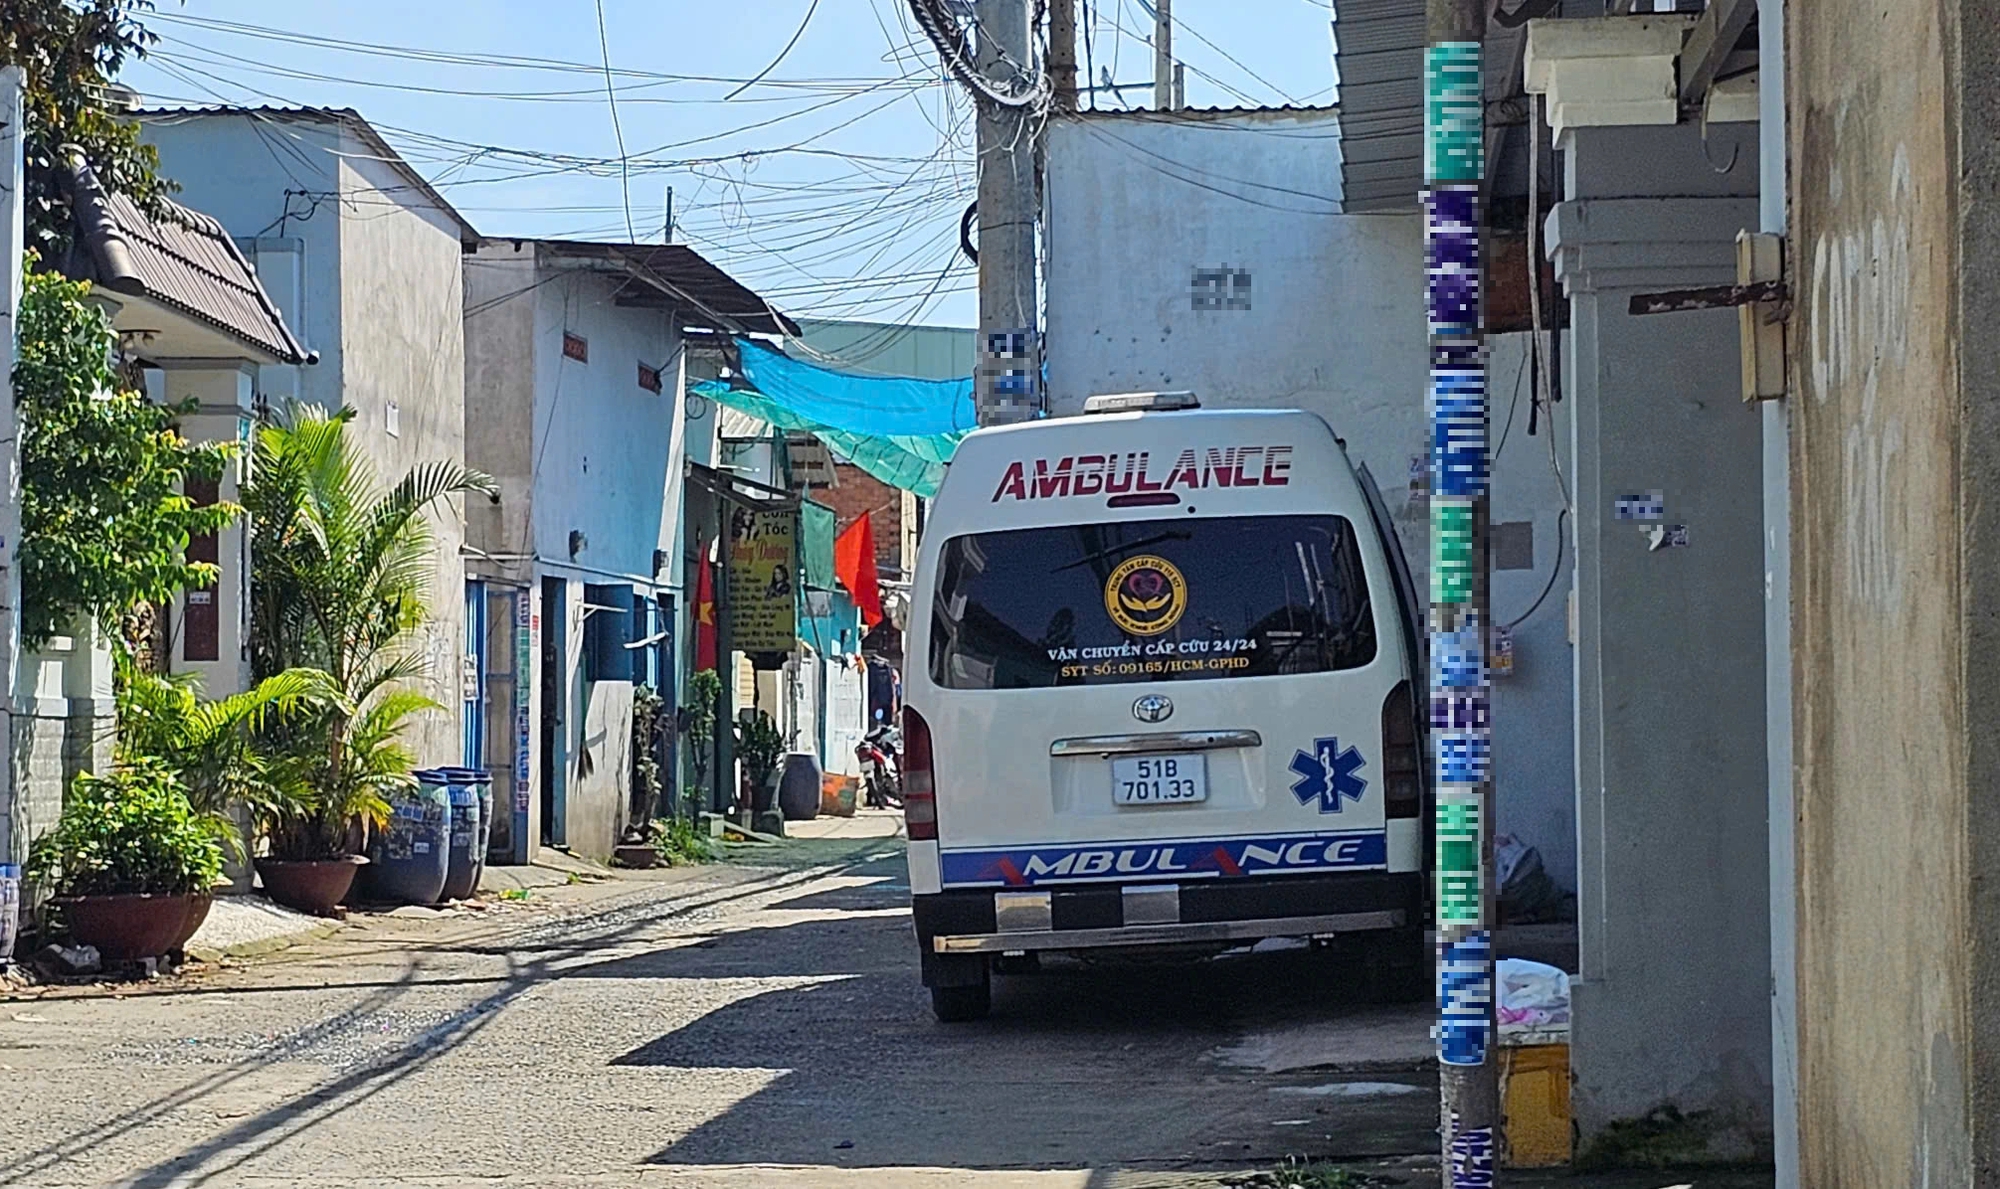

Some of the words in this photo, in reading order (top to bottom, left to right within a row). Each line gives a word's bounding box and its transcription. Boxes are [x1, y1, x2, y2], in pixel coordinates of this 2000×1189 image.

[991, 446, 1293, 502] AMBULANCE
[763, 521, 789, 535] Tóc
[1048, 648, 1077, 662] VẬN
[1082, 641, 1141, 659] CHUYỂN
[1145, 640, 1175, 656] CẤP
[1179, 640, 1209, 652] CỨU
[1213, 638, 1257, 652] 24/24
[1061, 665, 1088, 677] SYT
[1138, 759, 1177, 778] 51B
[1122, 779, 1195, 801] 701.33
[975, 839, 1363, 885] AMBULANCE
